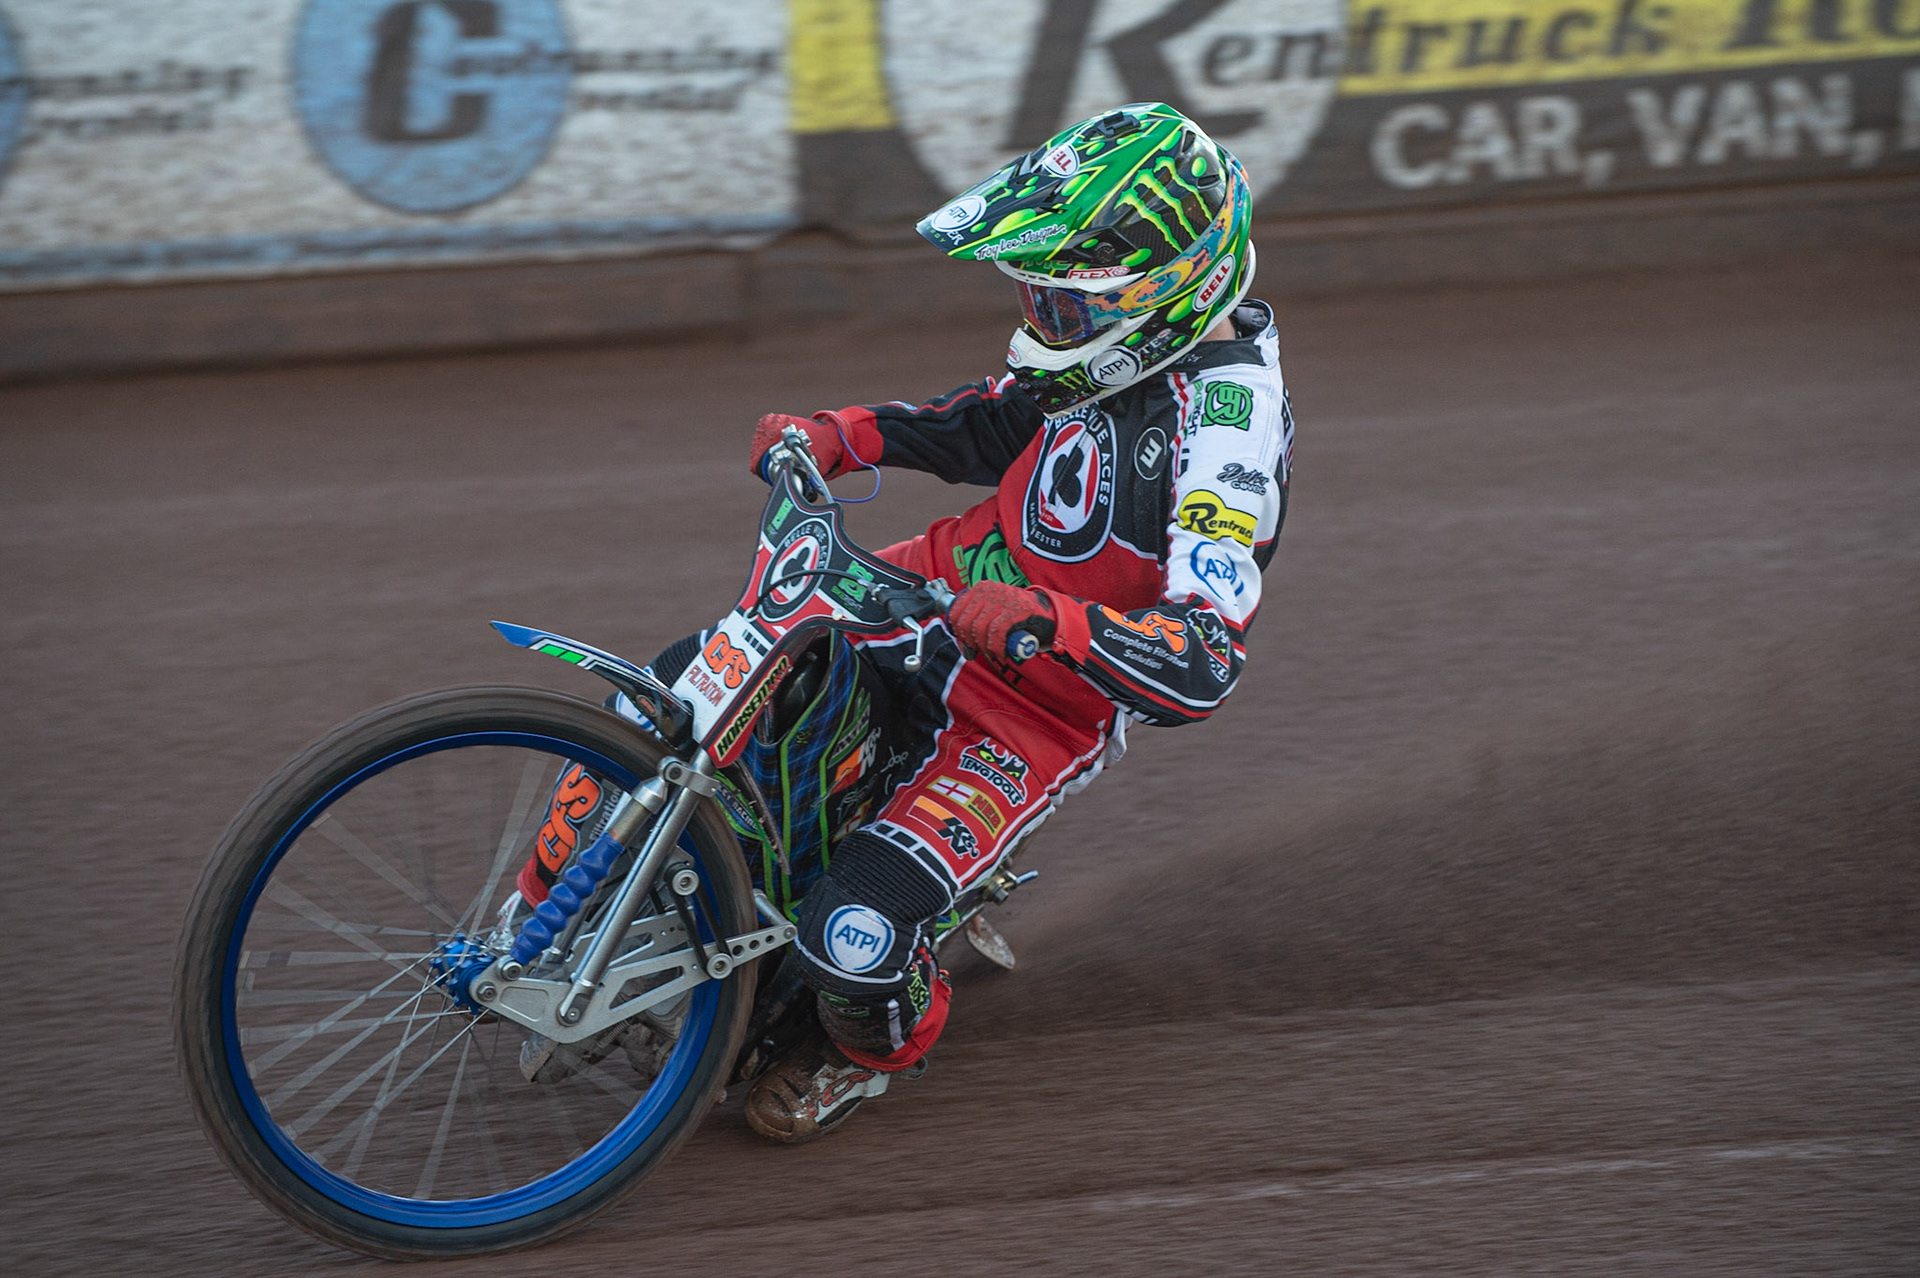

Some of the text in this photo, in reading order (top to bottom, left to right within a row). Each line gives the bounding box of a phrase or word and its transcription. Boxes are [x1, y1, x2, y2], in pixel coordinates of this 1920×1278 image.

[1370, 97, 1614, 188] CAR,
[1627, 72, 1884, 168] VAN,
[975, 244, 999, 260] Troy
[1000, 238, 1019, 252] Lee
[1068, 268, 1112, 279] FLEX
[1200, 265, 1230, 303] BELL
[1097, 358, 1130, 380] ATPI
[1098, 452, 1112, 506] ACES
[1103, 628, 1154, 653] Complete
[685, 664, 727, 707] FILTRATION
[835, 924, 881, 953] ATPI
